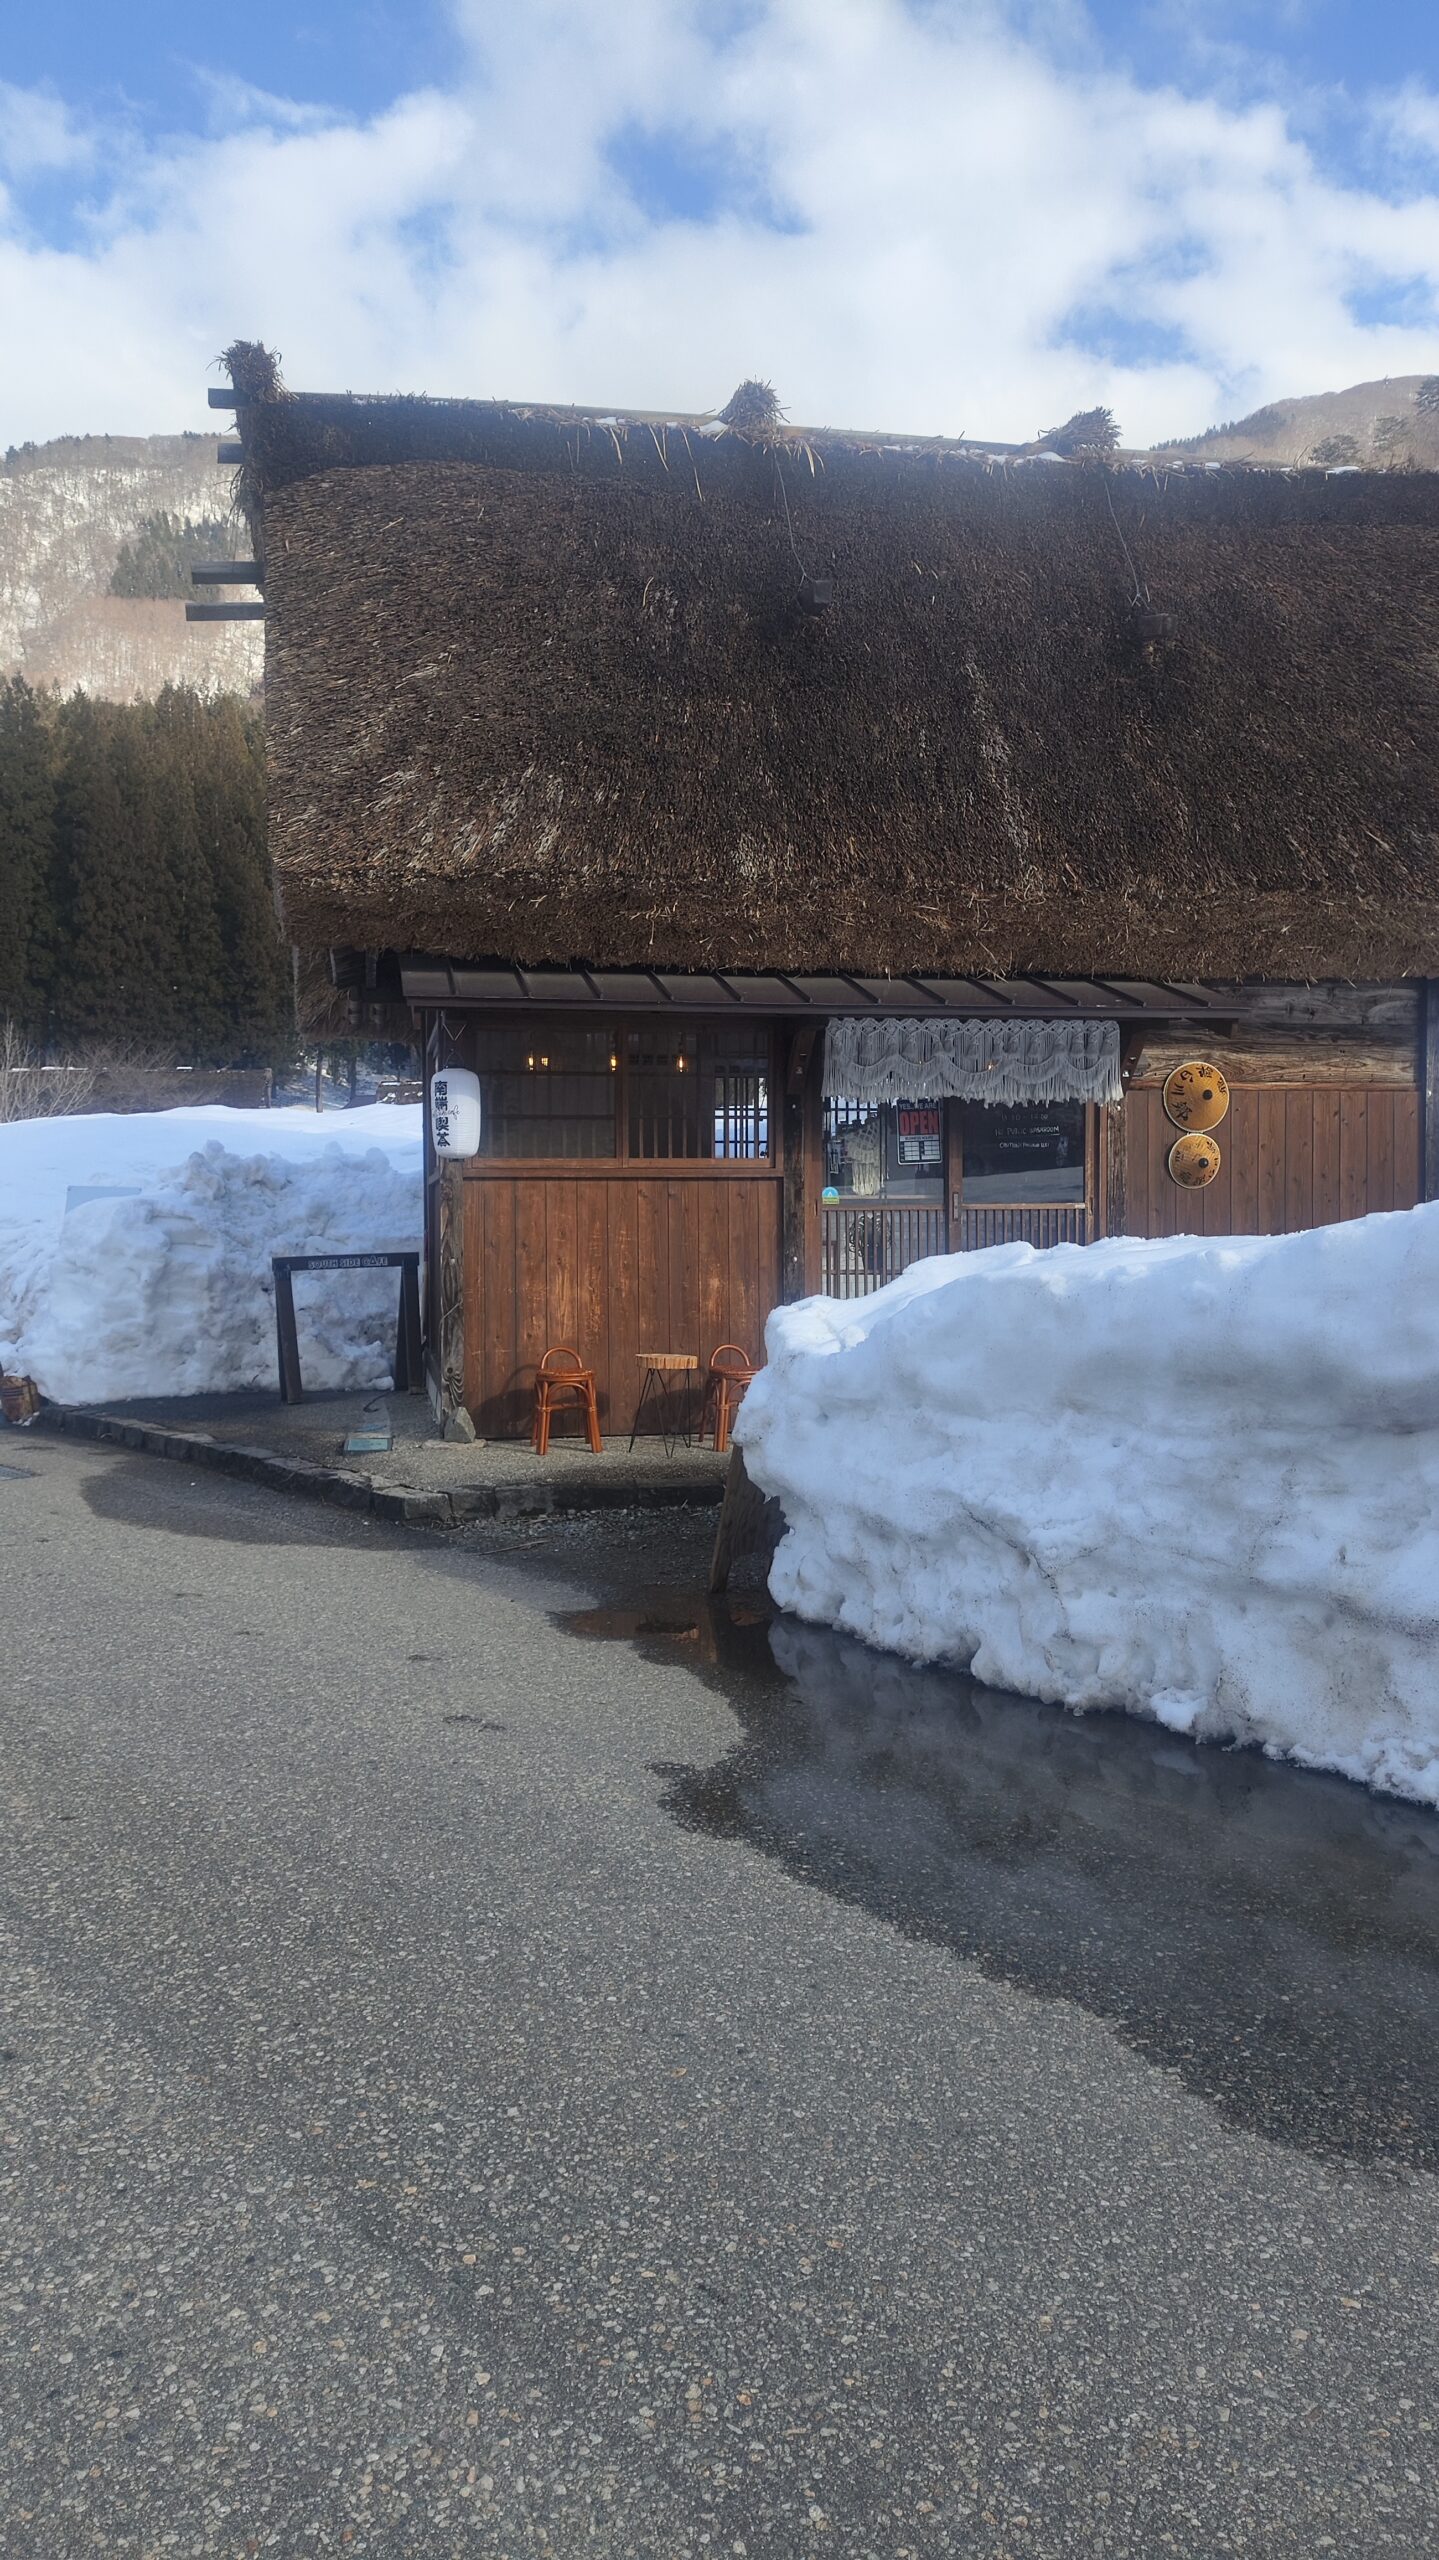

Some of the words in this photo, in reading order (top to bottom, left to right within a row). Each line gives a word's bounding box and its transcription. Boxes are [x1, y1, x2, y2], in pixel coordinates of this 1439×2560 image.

[900, 1111, 939, 1135] OPEN
[308, 1259, 338, 1269] SOUTH
[339, 1258, 360, 1268] SIDE
